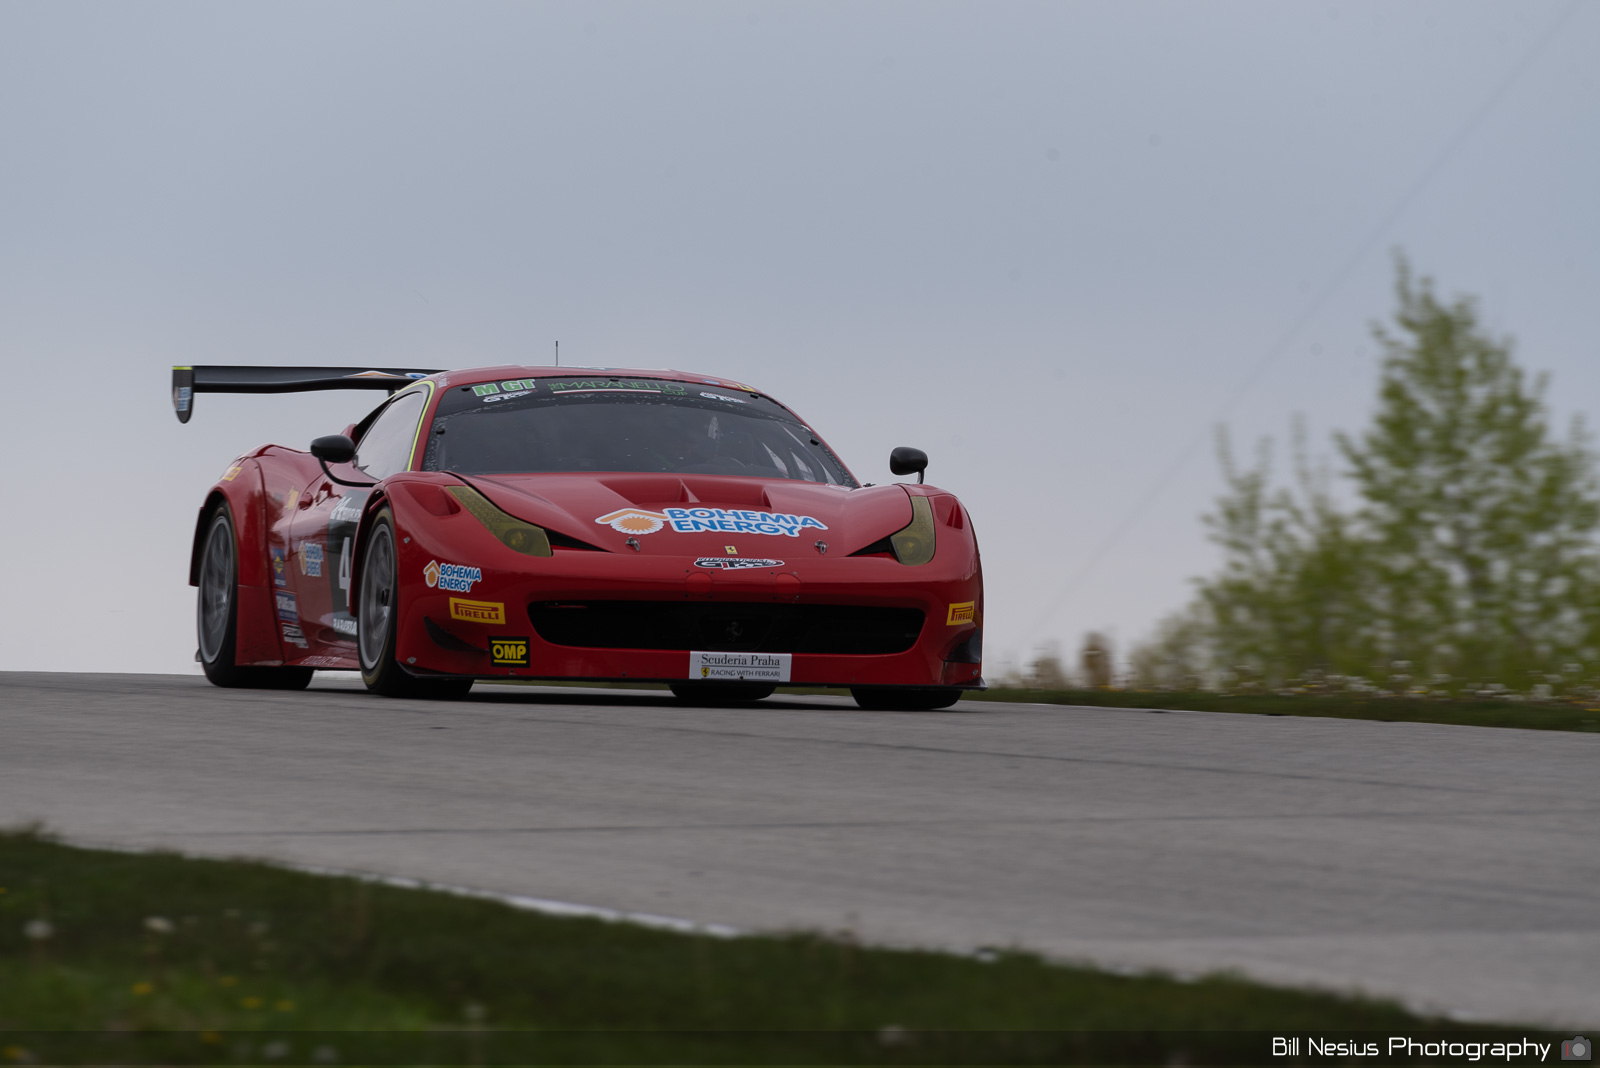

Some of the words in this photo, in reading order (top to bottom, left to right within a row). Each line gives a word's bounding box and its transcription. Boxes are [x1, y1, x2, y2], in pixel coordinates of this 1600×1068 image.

[472, 383, 500, 396] M
[501, 379, 535, 391] GT
[560, 381, 685, 392] MARANELLO
[667, 509, 826, 529] BOHEMIA
[676, 520, 800, 536] ENERGY
[440, 564, 482, 581] BOHEMIA
[439, 577, 473, 592] ENERGY
[454, 602, 500, 620] PIRELLI
[493, 645, 527, 659] OMP
[701, 654, 747, 665] Scuderia
[750, 655, 780, 666] Praha
